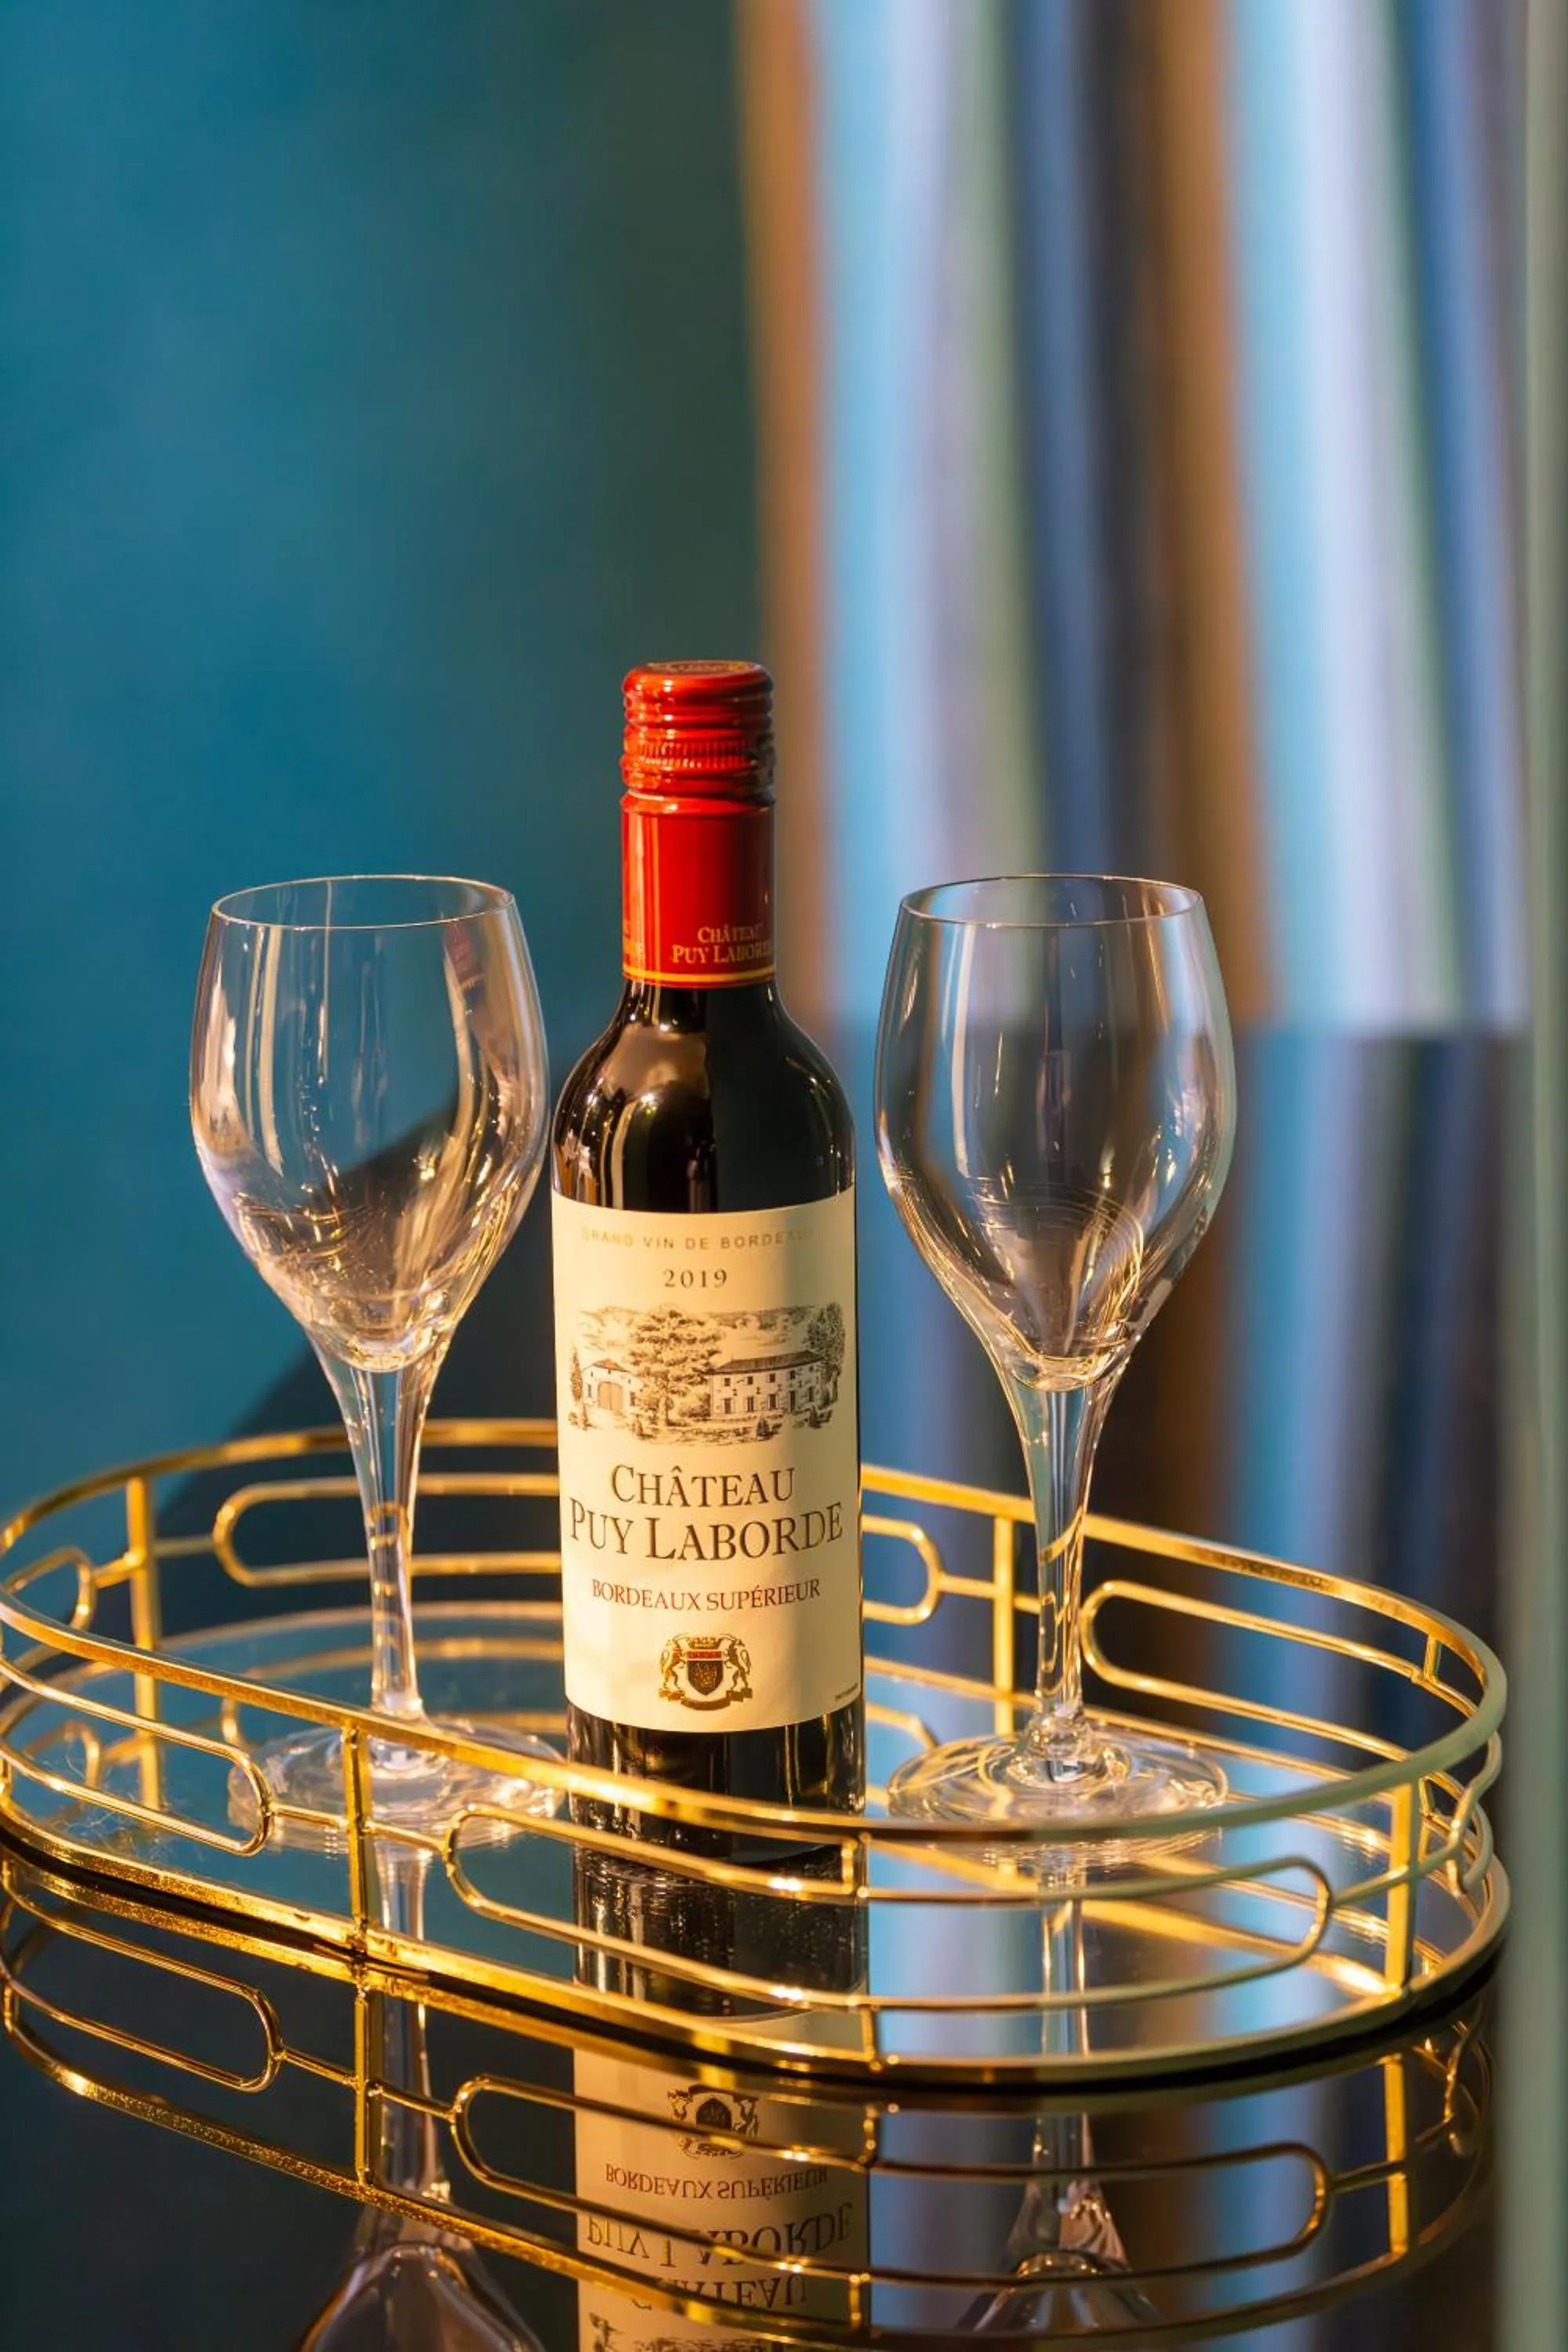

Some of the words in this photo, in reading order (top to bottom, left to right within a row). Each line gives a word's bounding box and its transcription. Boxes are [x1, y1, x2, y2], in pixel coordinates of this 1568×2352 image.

[670, 944, 708, 964] PUY
[713, 940, 773, 964] LABOR
[582, 1226, 633, 1247] GRAND
[644, 1237, 674, 1249] VIN
[684, 1238, 710, 1250] DE
[720, 1227, 815, 1250] BORDEAUX
[663, 1269, 728, 1289] 2019
[611, 1464, 795, 1508] CHÂTEAU
[569, 1497, 633, 1555] PUY
[645, 1501, 844, 1562] LABORDE
[592, 1579, 702, 1612] BORDEAUX
[706, 1578, 821, 1612] SUPÉRIEUR
